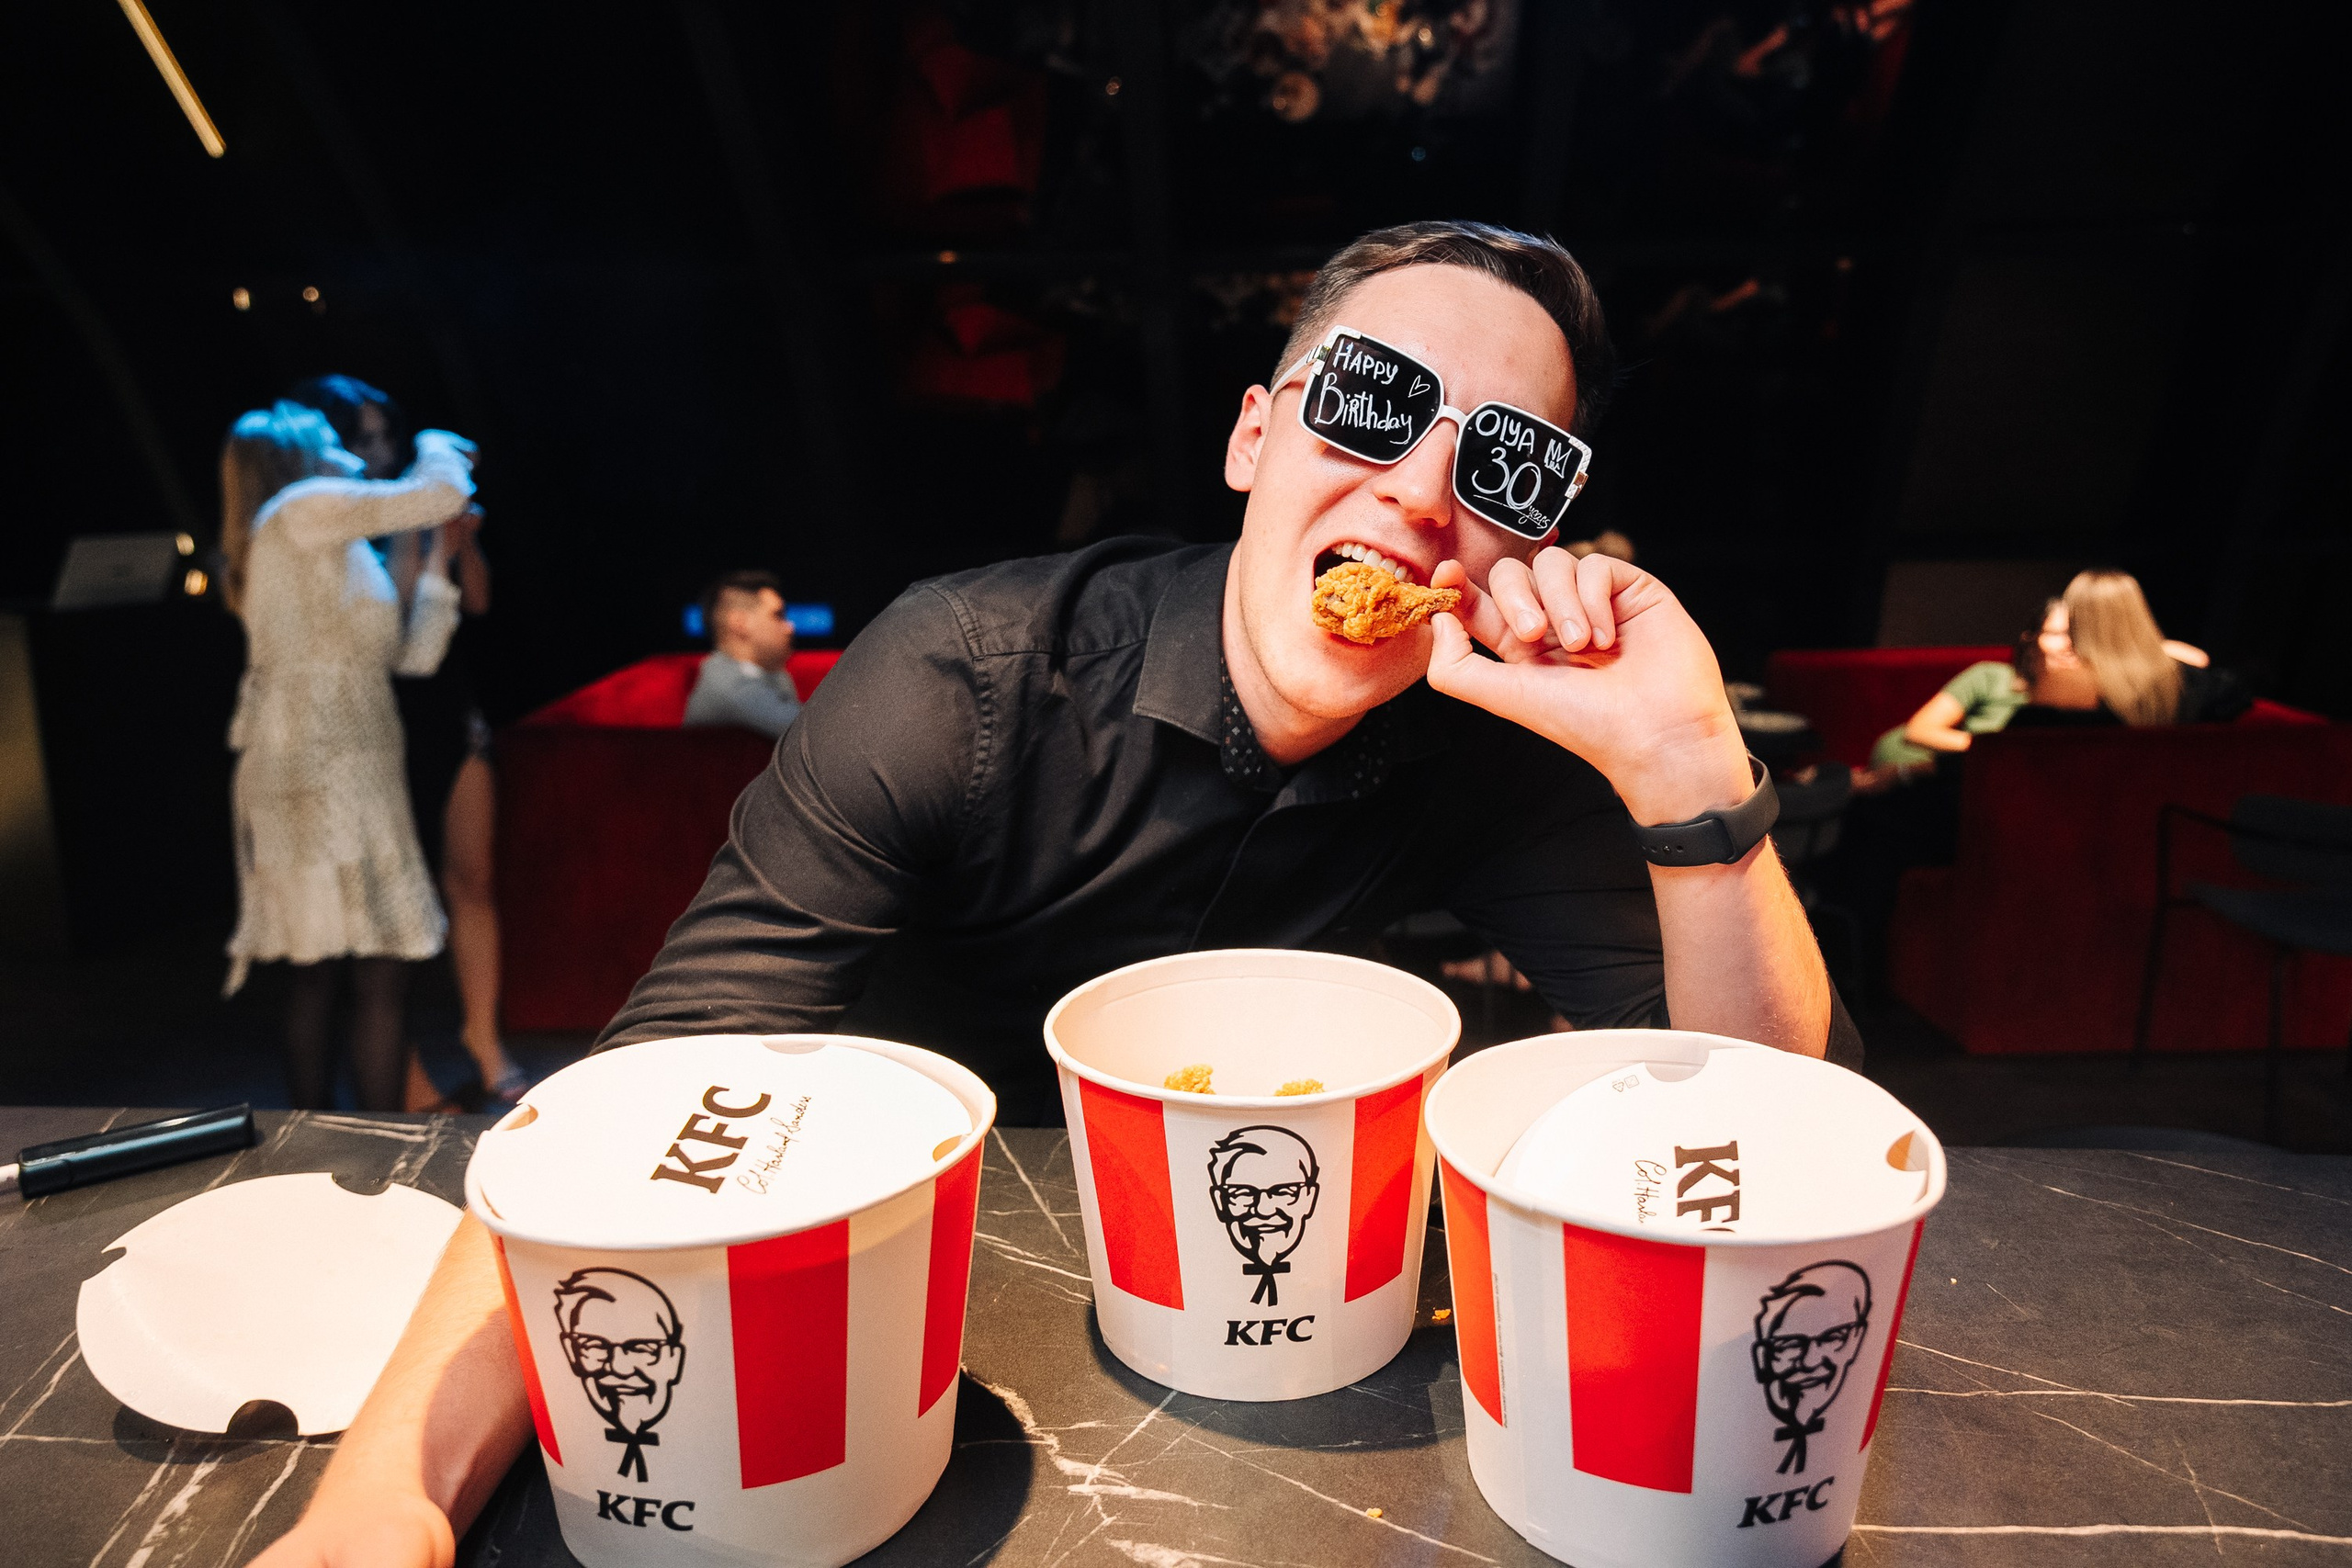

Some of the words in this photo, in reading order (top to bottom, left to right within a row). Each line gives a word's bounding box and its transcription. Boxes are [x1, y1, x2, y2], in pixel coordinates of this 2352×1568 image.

[1472, 446, 1542, 510] 30
[1518, 506, 1551, 529] years
[650, 1085, 772, 1194] KFC
[1674, 1140, 1740, 1232] KF
[1224, 1314, 1316, 1346] KFC
[596, 1489, 695, 1532] KFC
[1736, 1475, 1835, 1529] KFC
